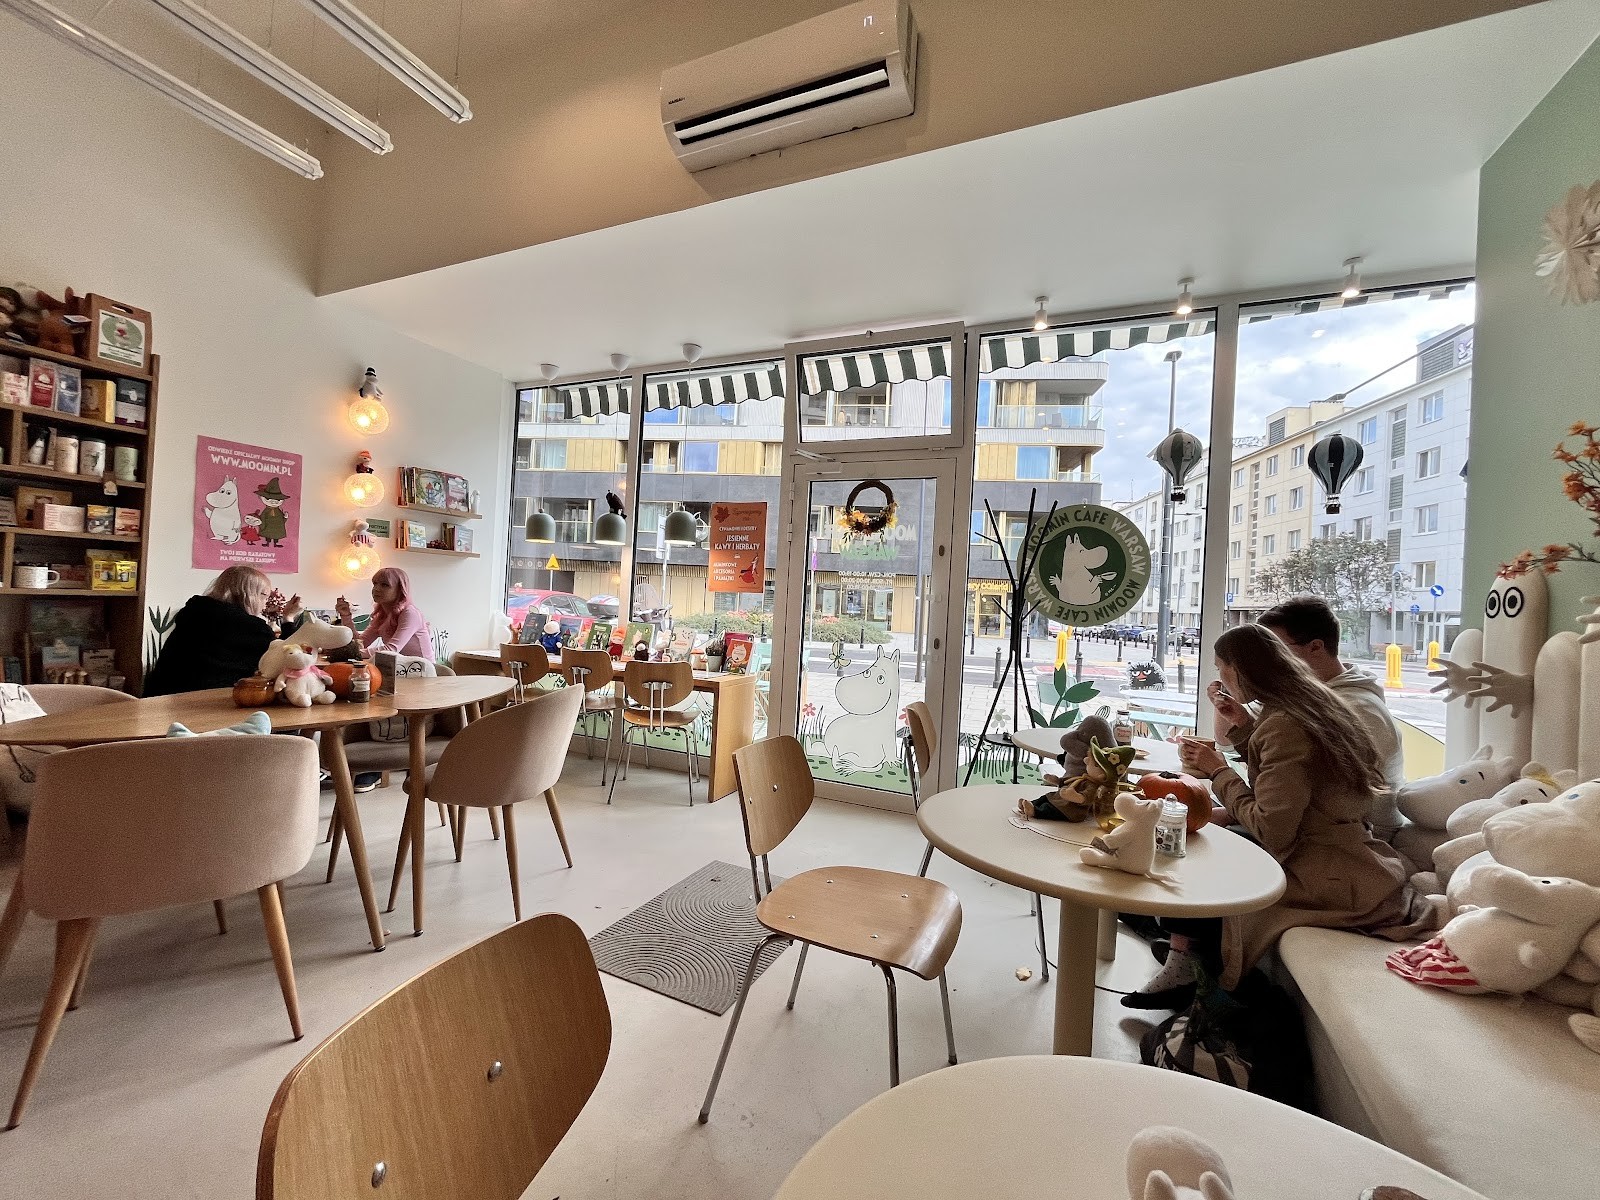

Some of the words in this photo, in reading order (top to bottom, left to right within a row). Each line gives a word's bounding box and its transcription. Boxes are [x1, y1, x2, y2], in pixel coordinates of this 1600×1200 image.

[211, 454, 292, 476] WWW.MOOMIN.PL
[726, 534, 749, 542] JESIENNE
[1074, 509, 1109, 525] CAFE
[1111, 517, 1146, 575] WARSAW
[1093, 578, 1141, 621] MOOMIN
[1055, 605, 1089, 623] CAFE
